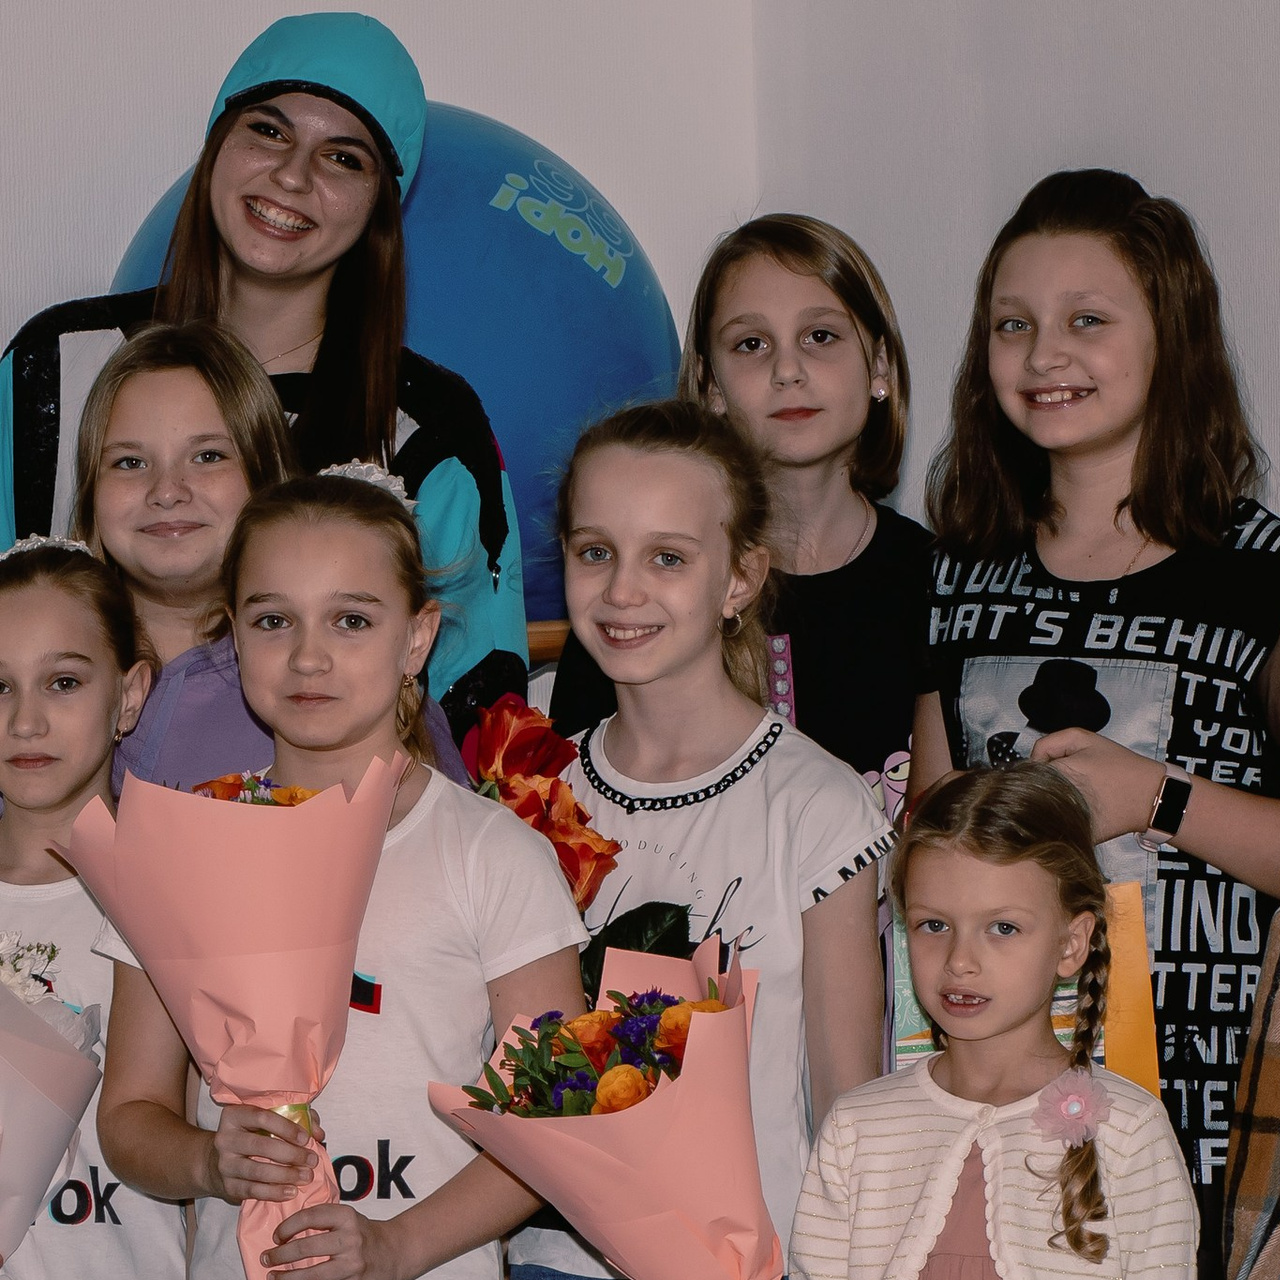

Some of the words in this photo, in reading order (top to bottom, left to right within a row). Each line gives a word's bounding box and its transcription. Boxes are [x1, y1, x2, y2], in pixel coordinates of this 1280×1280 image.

[1084, 613, 1268, 682] BEHIN
[617, 838, 706, 900] ODUCING
[48, 1166, 123, 1226] ok
[332, 1139, 416, 1201] ok
